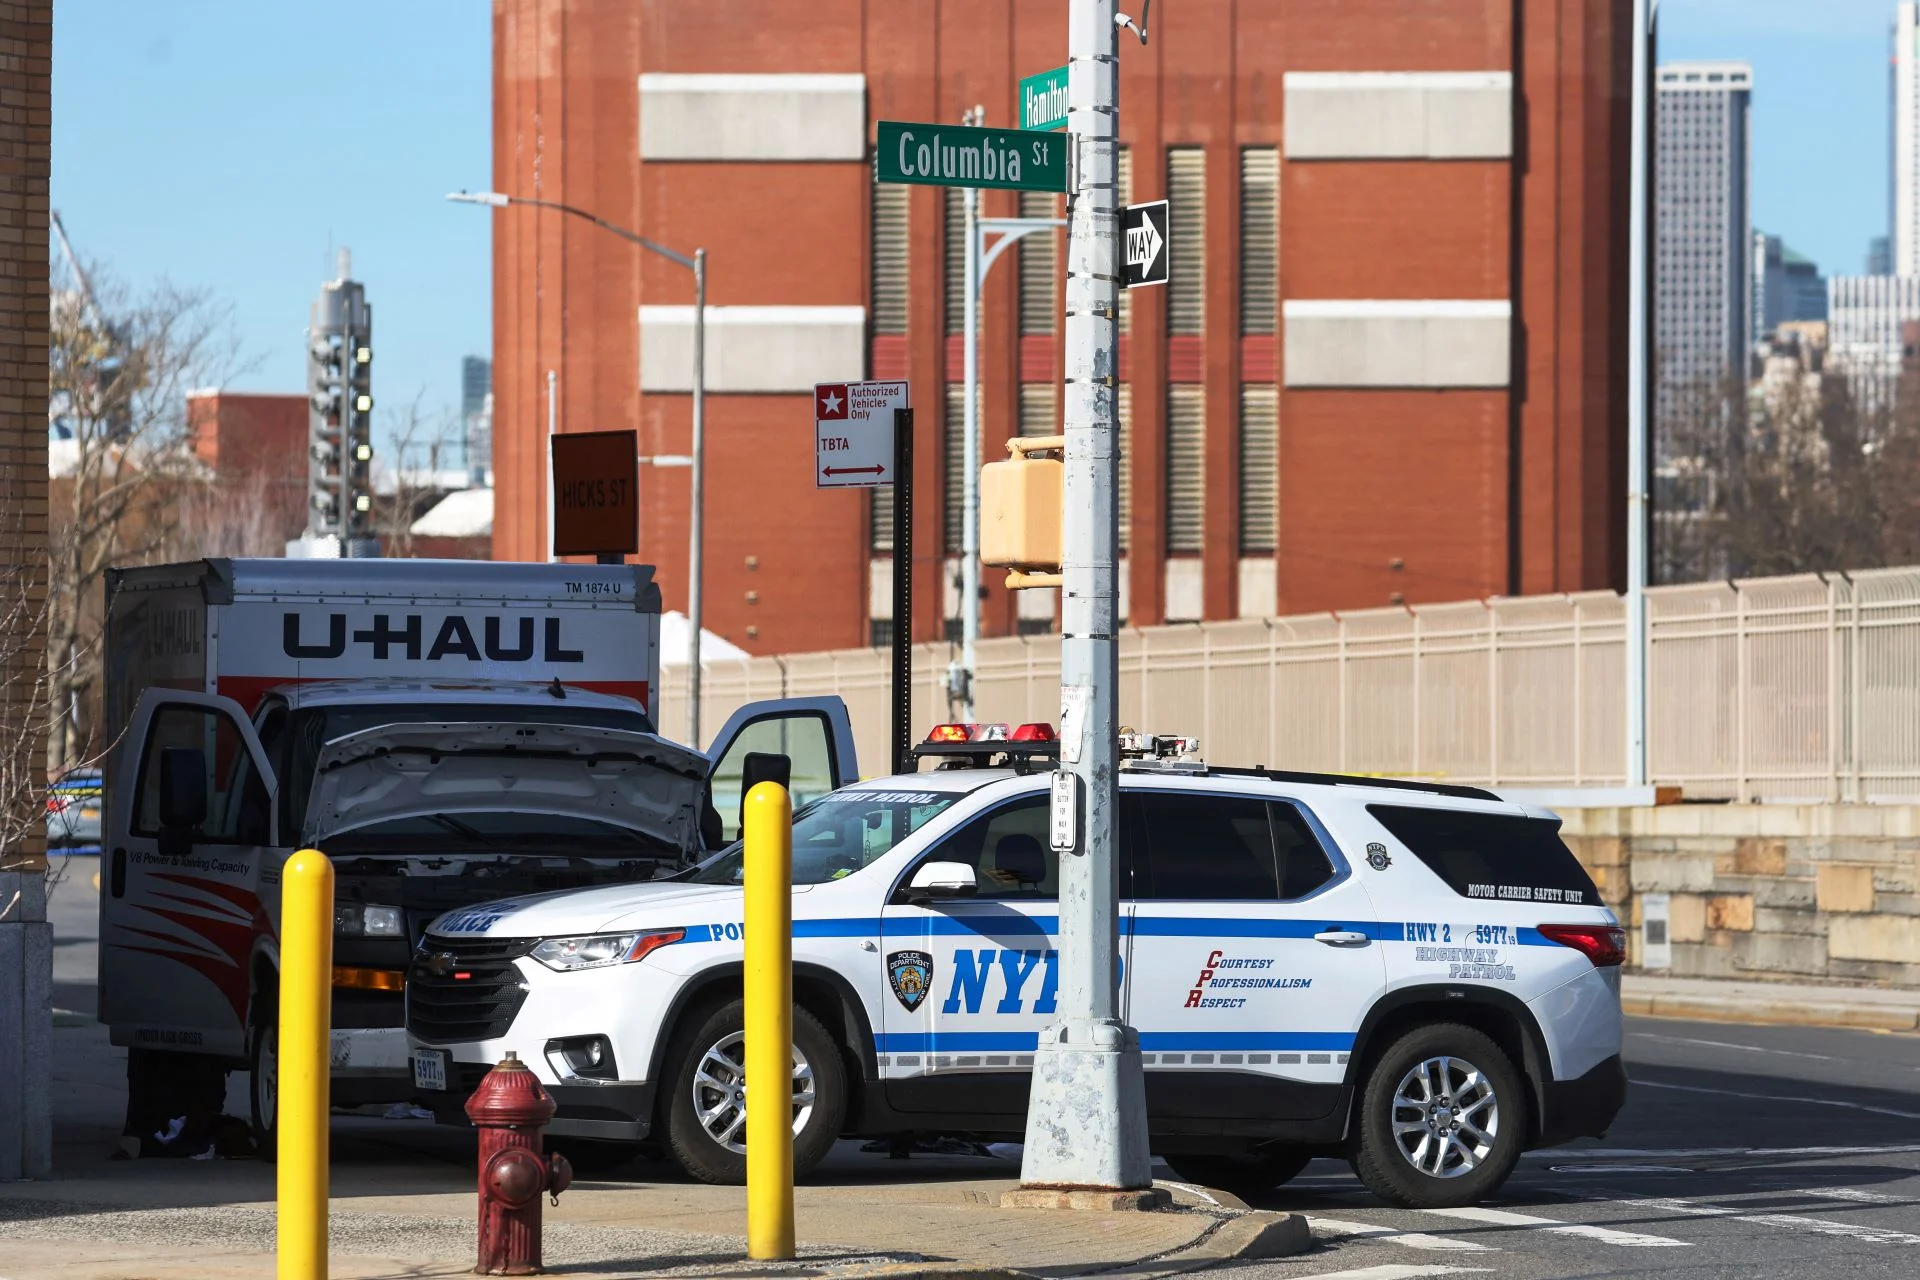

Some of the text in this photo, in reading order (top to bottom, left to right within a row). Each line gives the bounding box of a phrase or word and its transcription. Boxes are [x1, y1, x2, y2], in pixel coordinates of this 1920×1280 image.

[1026, 78, 1068, 128] Hamilton
[900, 131, 1049, 182] Columbia St
[1128, 229, 1154, 262] WAY
[851, 386, 899, 398] Authorized
[851, 399, 887, 408] Vehicles
[851, 410, 870, 421] Only
[821, 438, 849, 451] TBTA
[562, 478, 628, 509] HICKS ST
[565, 582, 621, 594] TM 1874 U
[283, 613, 583, 663] U-HAUL
[868, 793, 938, 803] PATROL
[129, 851, 142, 864] V8
[143, 853, 170, 866] Power
[211, 858, 250, 876] Capacity
[1467, 884, 1583, 903] MOTOR CARRIER SAFETY UNIT
[1406, 922, 1437, 943] HWY
[1442, 923, 1451, 943] 2
[890, 958, 930, 970] DEPARTMENT
[1206, 950, 1274, 969] COURTESY
[1416, 947, 1498, 963] HIGHWAY
[1195, 970, 1313, 988] PROFESSIONALISM
[1449, 964, 1516, 980] PATROL
[1184, 990, 1246, 1008] RESPECT
[417, 1059, 436, 1080] 5977
